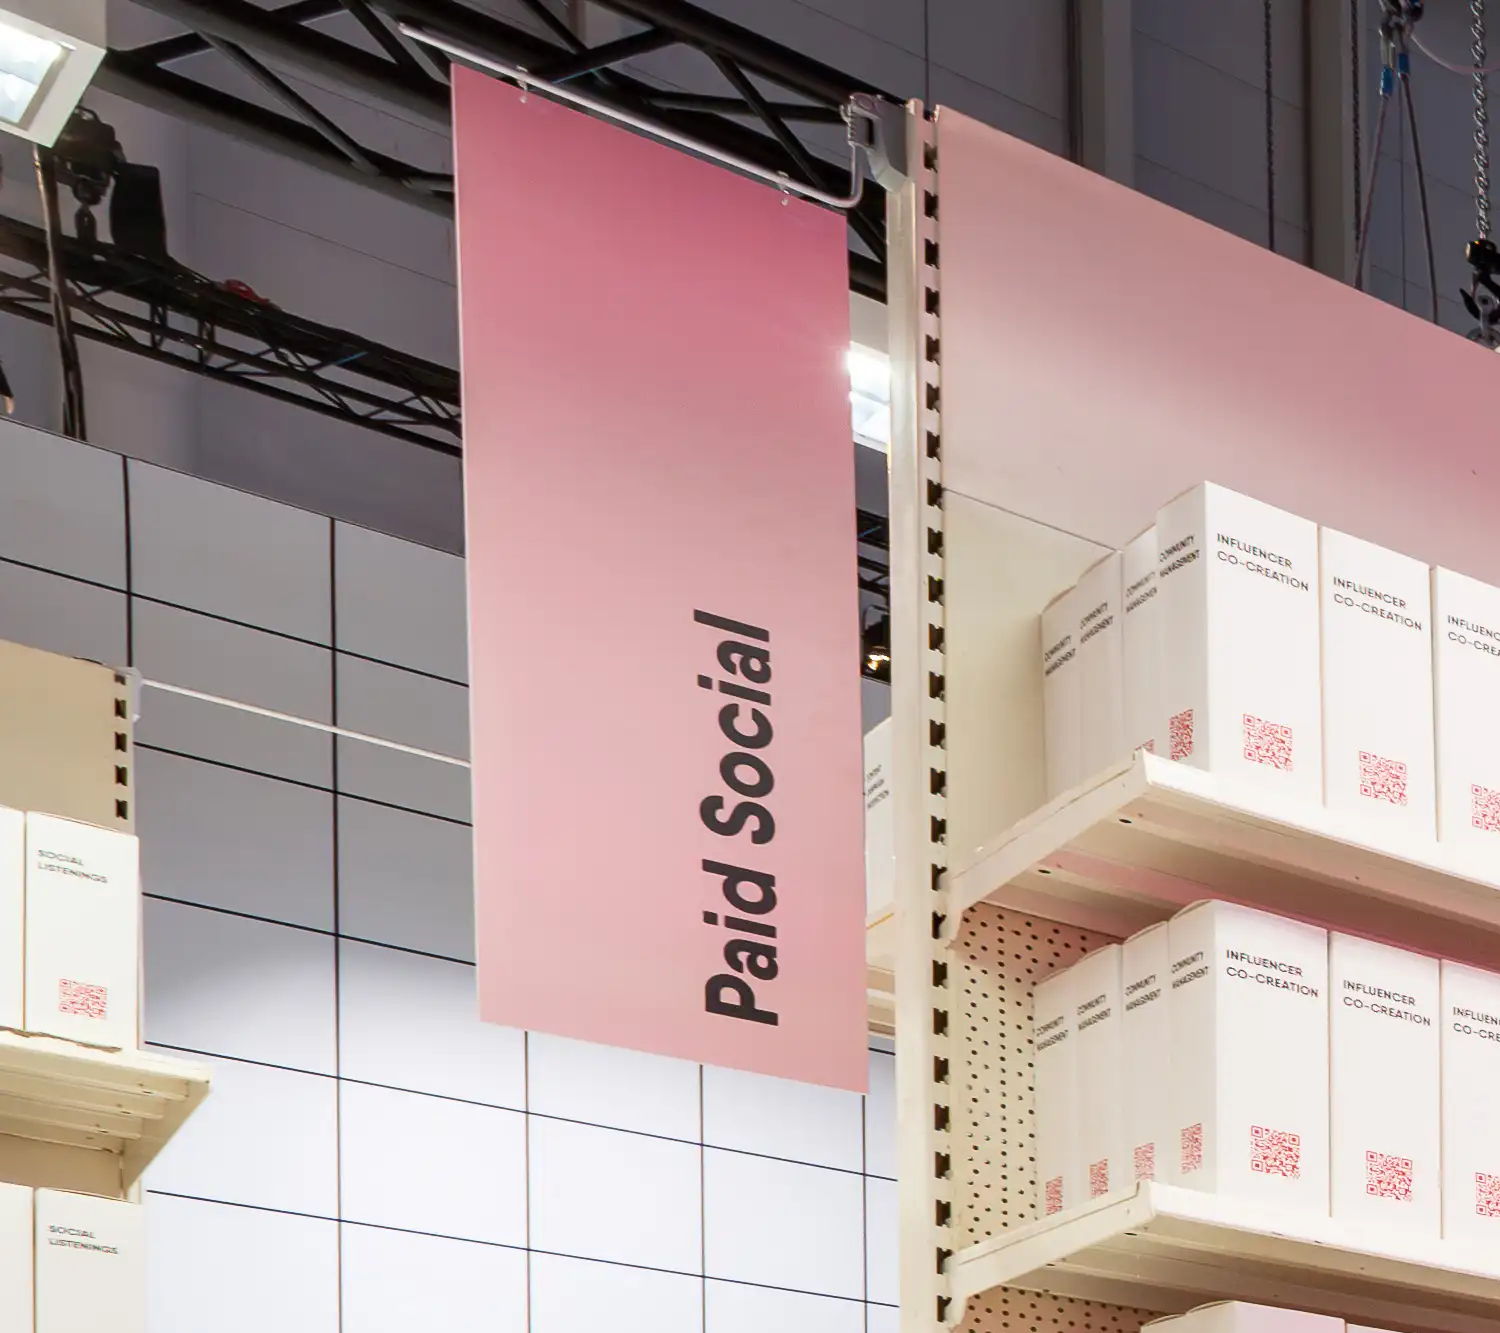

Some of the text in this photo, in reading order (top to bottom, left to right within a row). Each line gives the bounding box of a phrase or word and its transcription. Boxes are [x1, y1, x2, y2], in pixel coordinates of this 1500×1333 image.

[1216, 532, 1293, 570] INFLUENCER
[1216, 550, 1309, 592] CO-CREATION
[1333, 576, 1407, 610] INFLUENCER
[1333, 593, 1422, 632] CO-CREATION
[693, 609, 778, 1026] Paid Social
[37, 849, 85, 867] SOCIAL
[37, 861, 109, 884] LISTENINGS
[1225, 949, 1304, 978] INFLUENCER
[1225, 966, 1319, 998] CO-CREATION
[1343, 979, 1416, 1007] INFLUENCER
[1342, 996, 1431, 1027] CO-CREATION
[47, 1224, 97, 1239] SOCIAL
[47, 1238, 120, 1255] LISTENINGS
